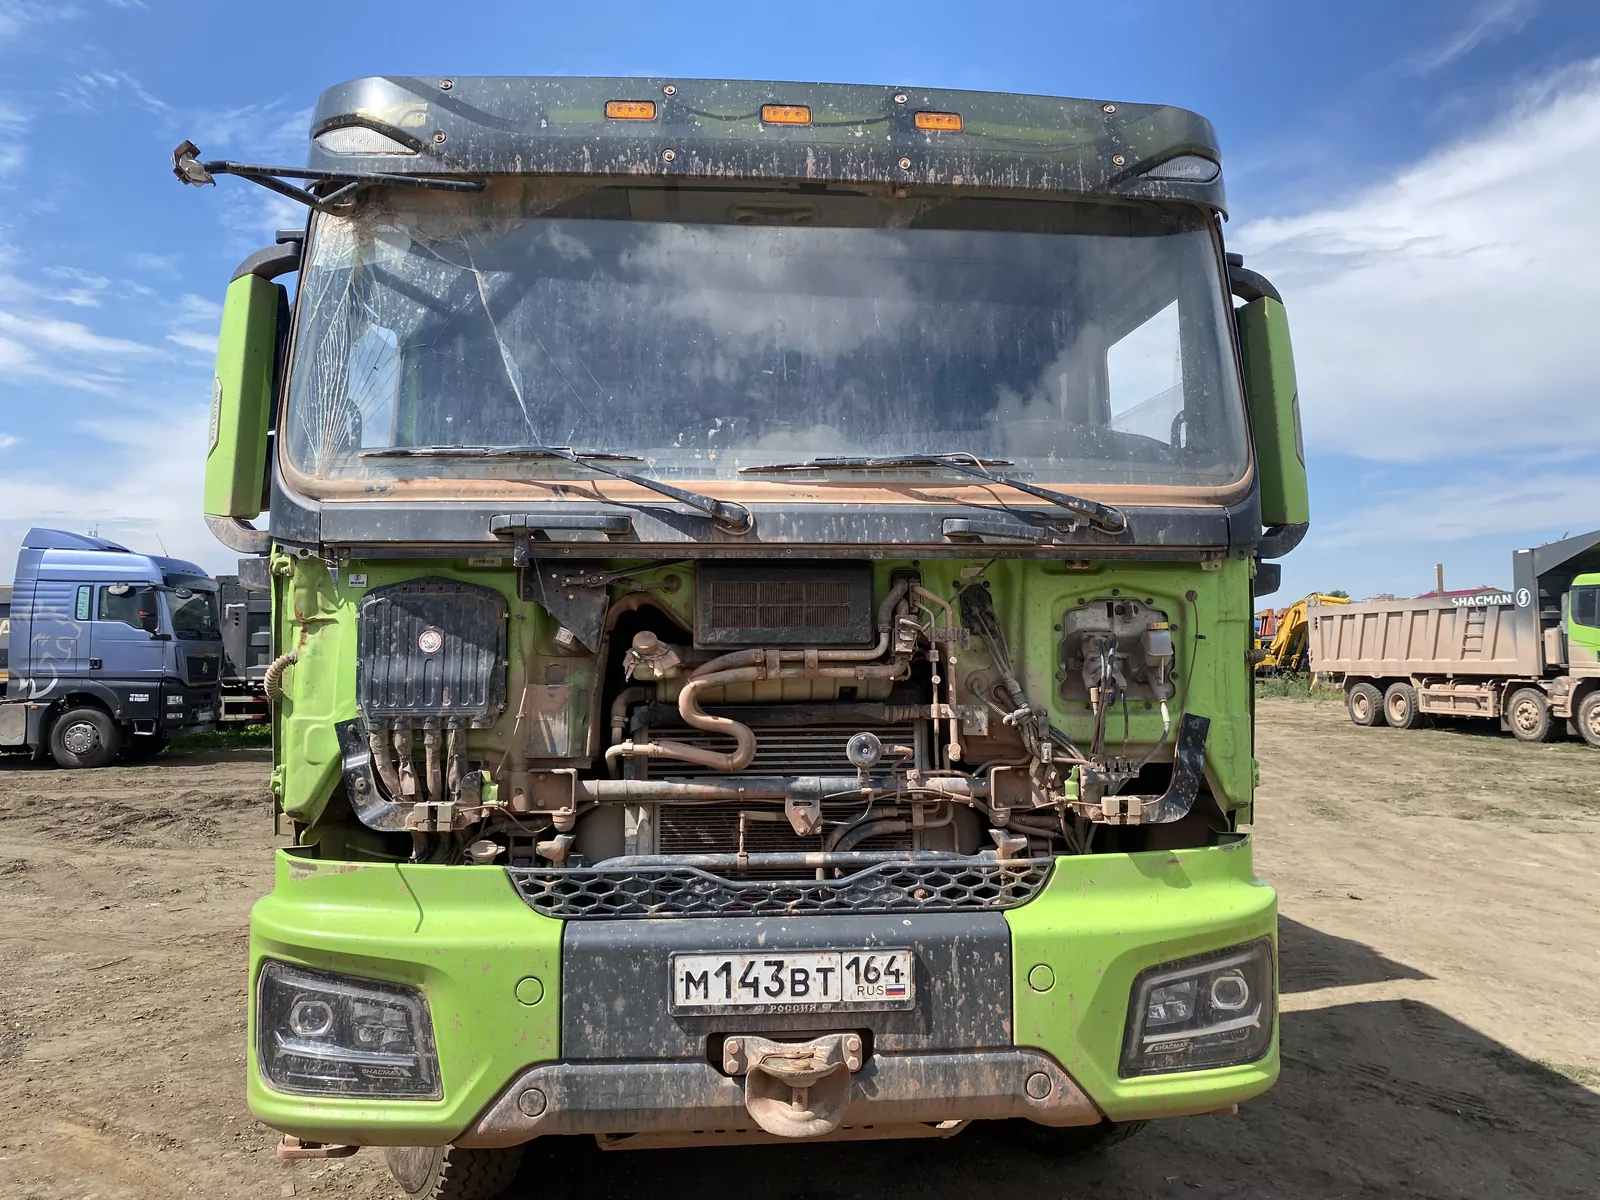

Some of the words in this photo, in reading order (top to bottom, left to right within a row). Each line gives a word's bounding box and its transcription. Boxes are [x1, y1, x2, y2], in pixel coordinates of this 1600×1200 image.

[1451, 594, 1512, 607] SHACMAN
[845, 955, 900, 985] 164
[857, 985, 884, 996] RUS
